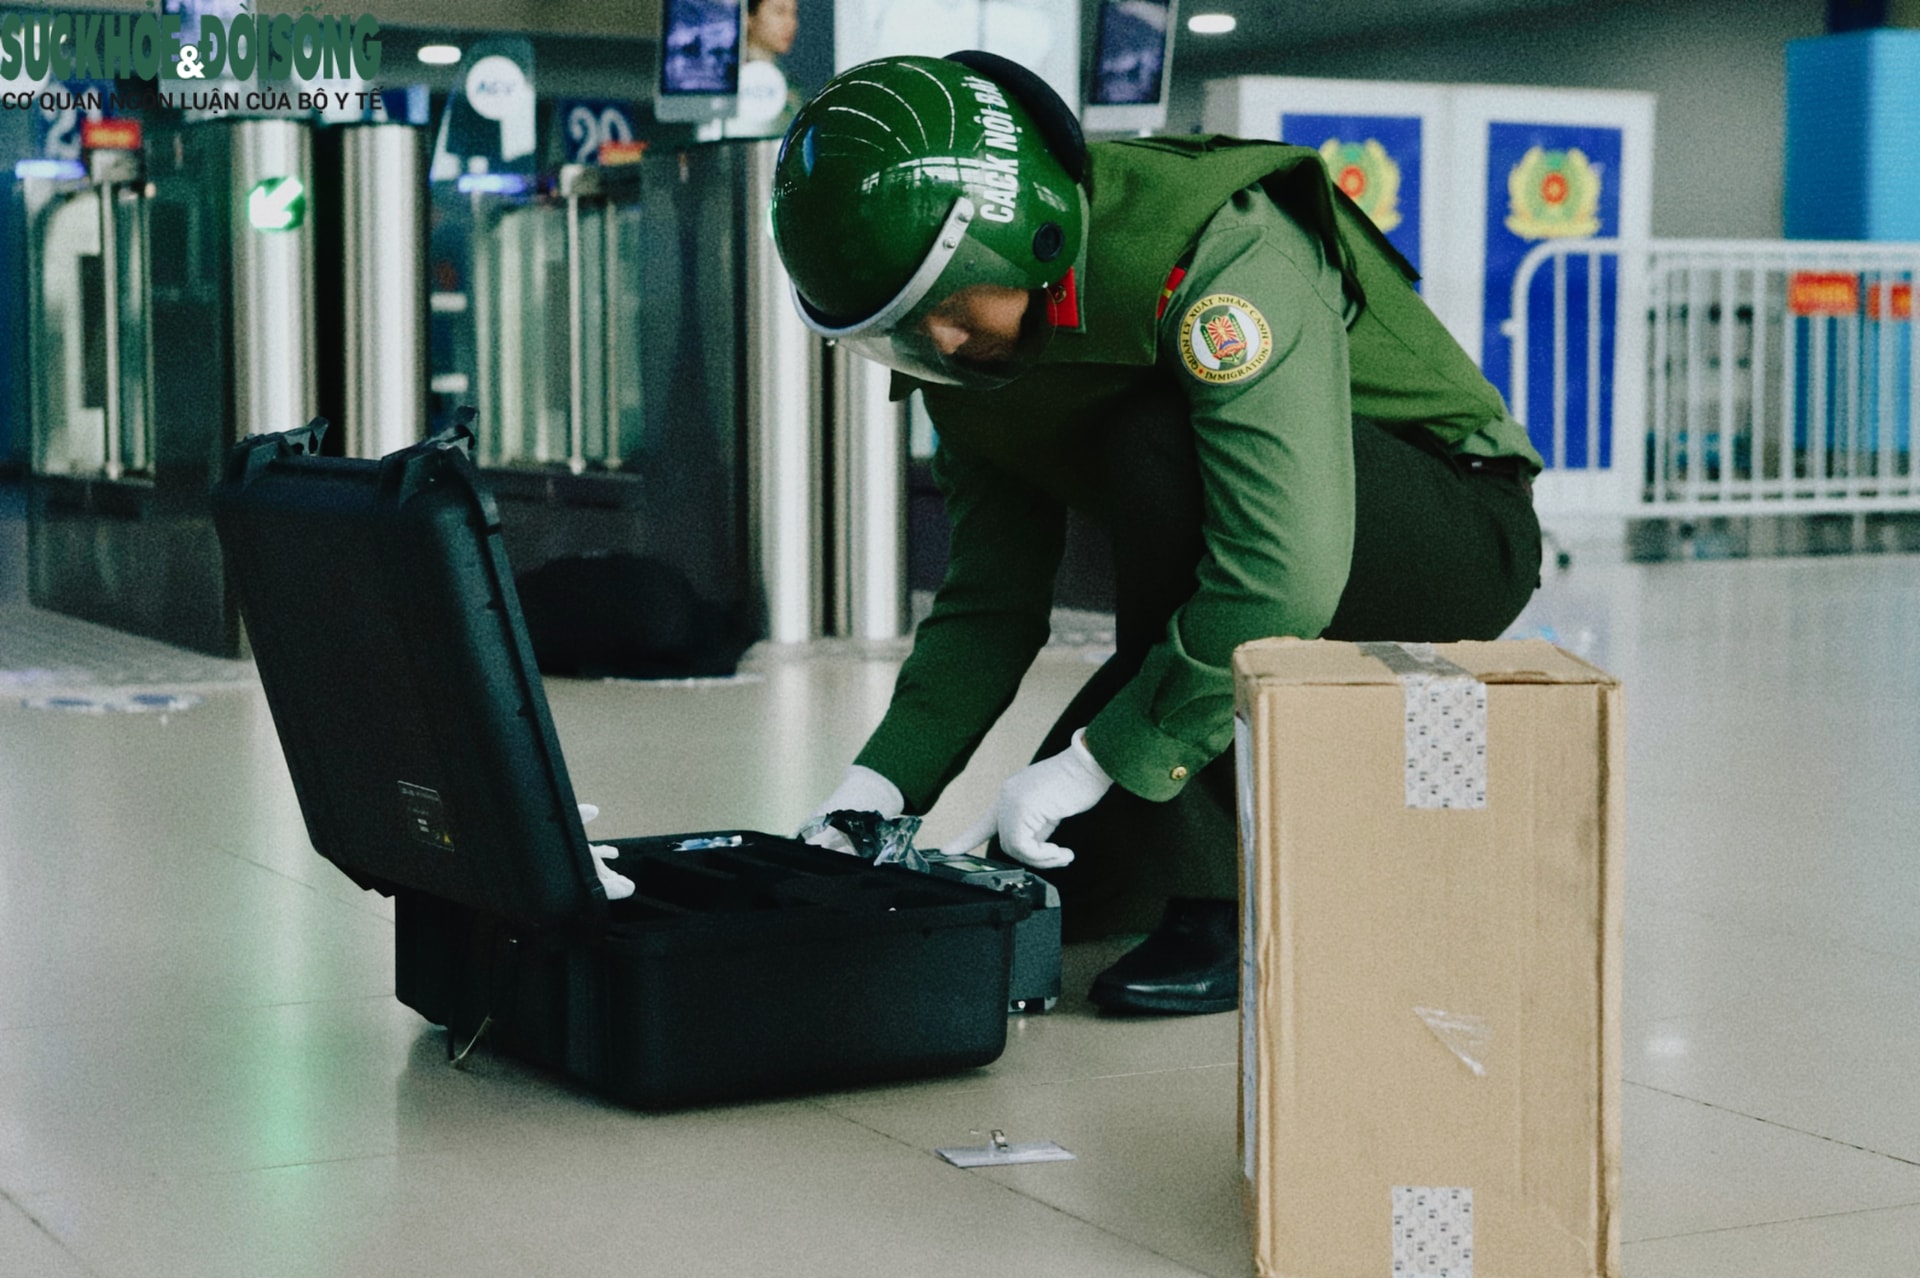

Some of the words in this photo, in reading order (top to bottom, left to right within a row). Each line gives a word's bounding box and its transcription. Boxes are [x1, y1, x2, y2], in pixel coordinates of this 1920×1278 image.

[973, 108, 1023, 152] NỘI
[980, 153, 1018, 223] CACK
[1205, 348, 1269, 381] IMMIGRATION
